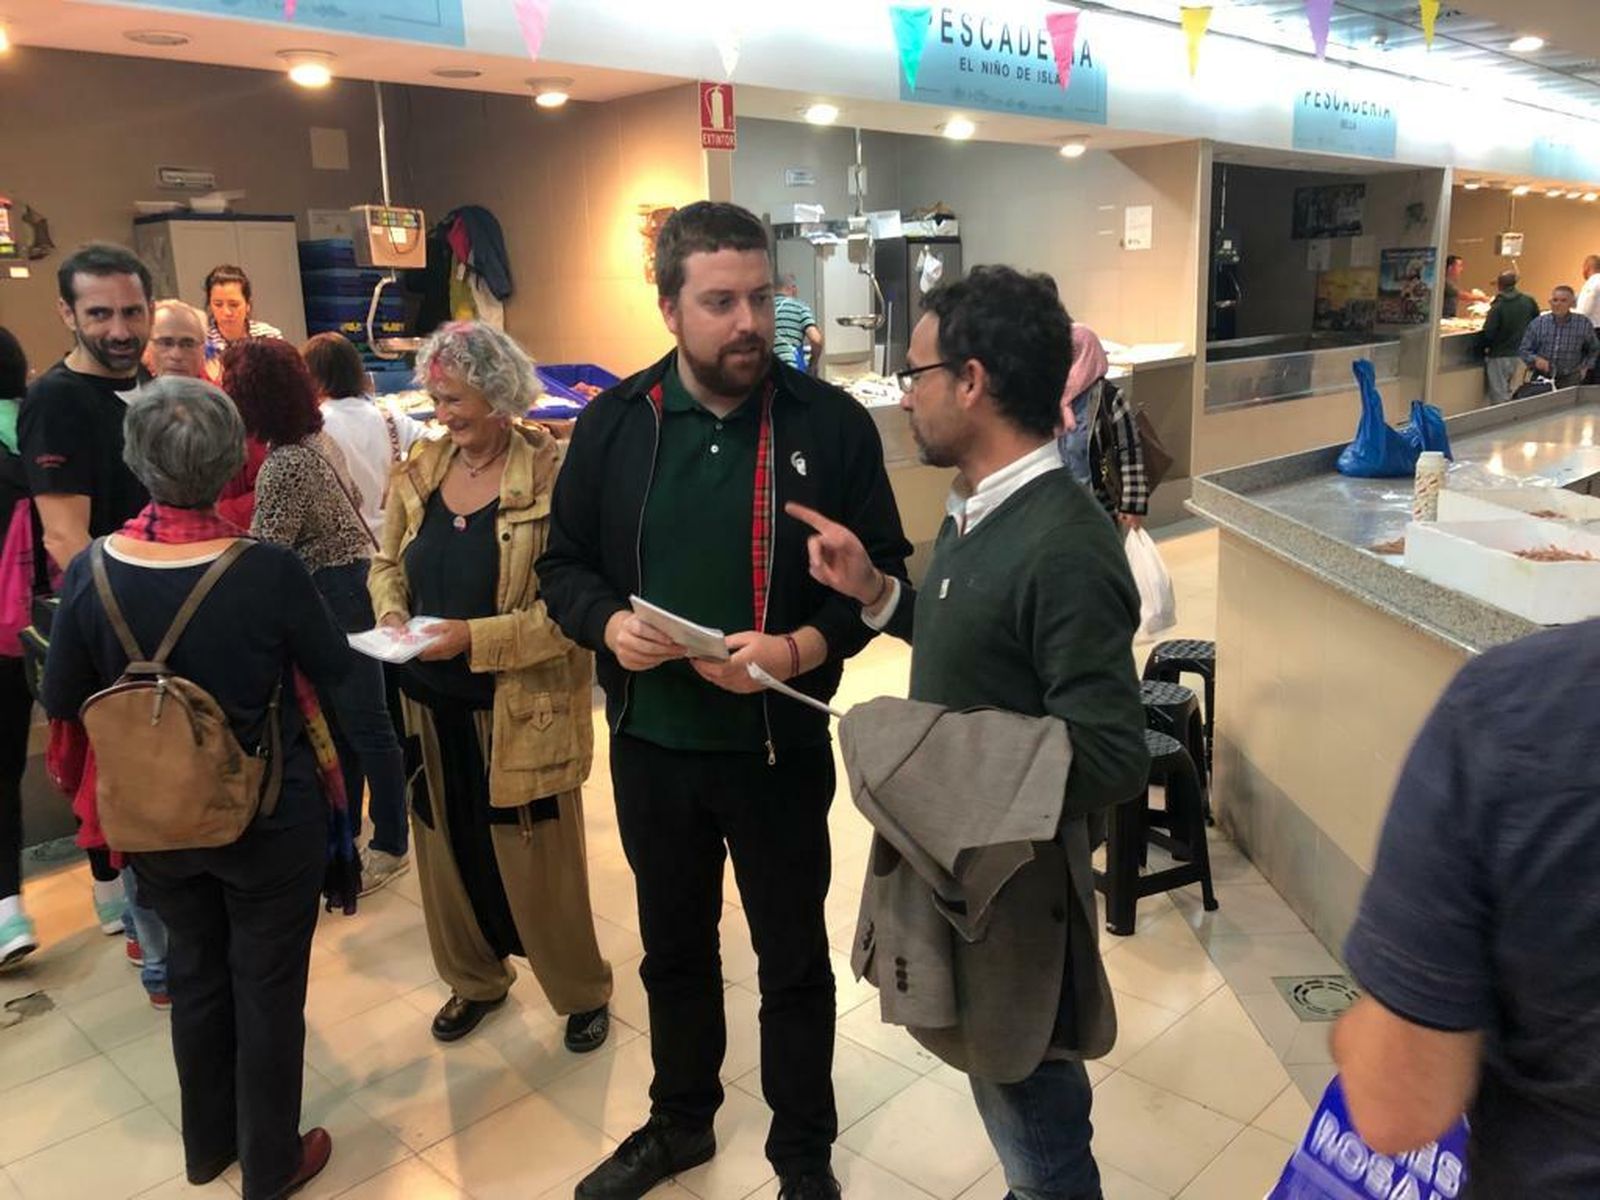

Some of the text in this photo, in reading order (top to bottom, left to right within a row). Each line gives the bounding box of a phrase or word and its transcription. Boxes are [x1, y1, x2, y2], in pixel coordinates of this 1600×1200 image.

[960, 56, 974, 73] EL
[981, 59, 1010, 77] NIÑO
[1016, 66, 1031, 81] DE
